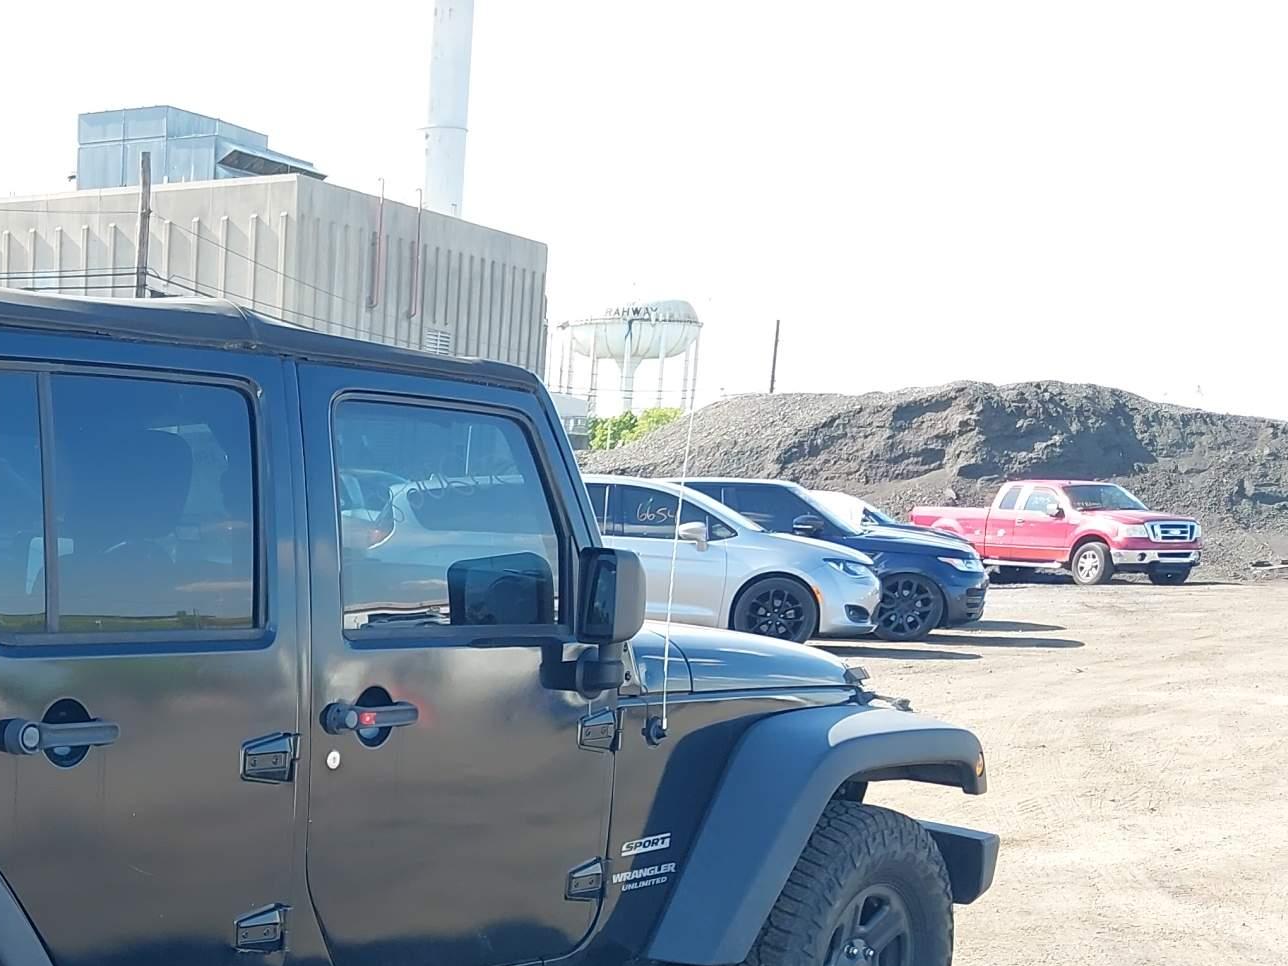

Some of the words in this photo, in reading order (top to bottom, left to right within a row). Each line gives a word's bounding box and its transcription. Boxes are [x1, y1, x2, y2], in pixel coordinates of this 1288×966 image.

[605, 306, 658, 318] RAHWAY
[624, 836, 669, 852] SPORT
[612, 862, 676, 884] WRANGLER
[621, 876, 668, 891] UNLIMITED
